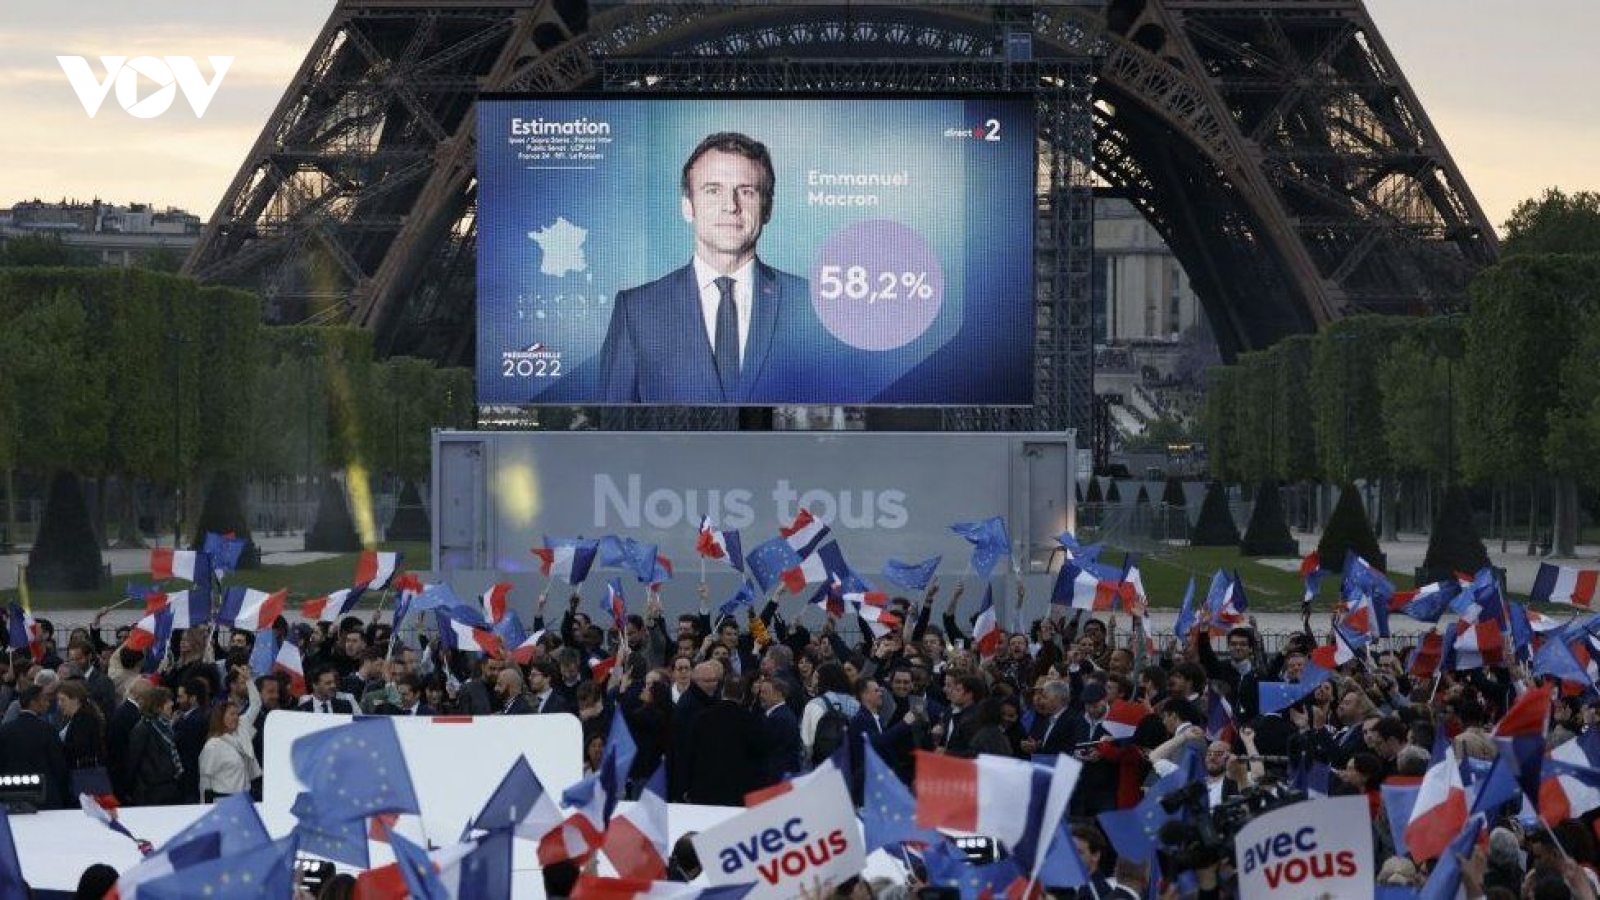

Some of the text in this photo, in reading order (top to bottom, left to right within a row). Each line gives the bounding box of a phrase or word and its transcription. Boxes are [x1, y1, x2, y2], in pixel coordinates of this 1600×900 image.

[512, 118, 611, 135] Estimation
[985, 119, 1000, 141] 2
[808, 170, 908, 186] Emmanuel
[808, 191, 879, 206] Macron
[820, 265, 932, 304] 58,2%
[502, 360, 561, 377] 2022
[593, 473, 909, 529] Nous tous
[719, 817, 808, 874] avec
[757, 828, 848, 886] vous
[1243, 825, 1317, 875] avec
[1263, 850, 1357, 890] vous
